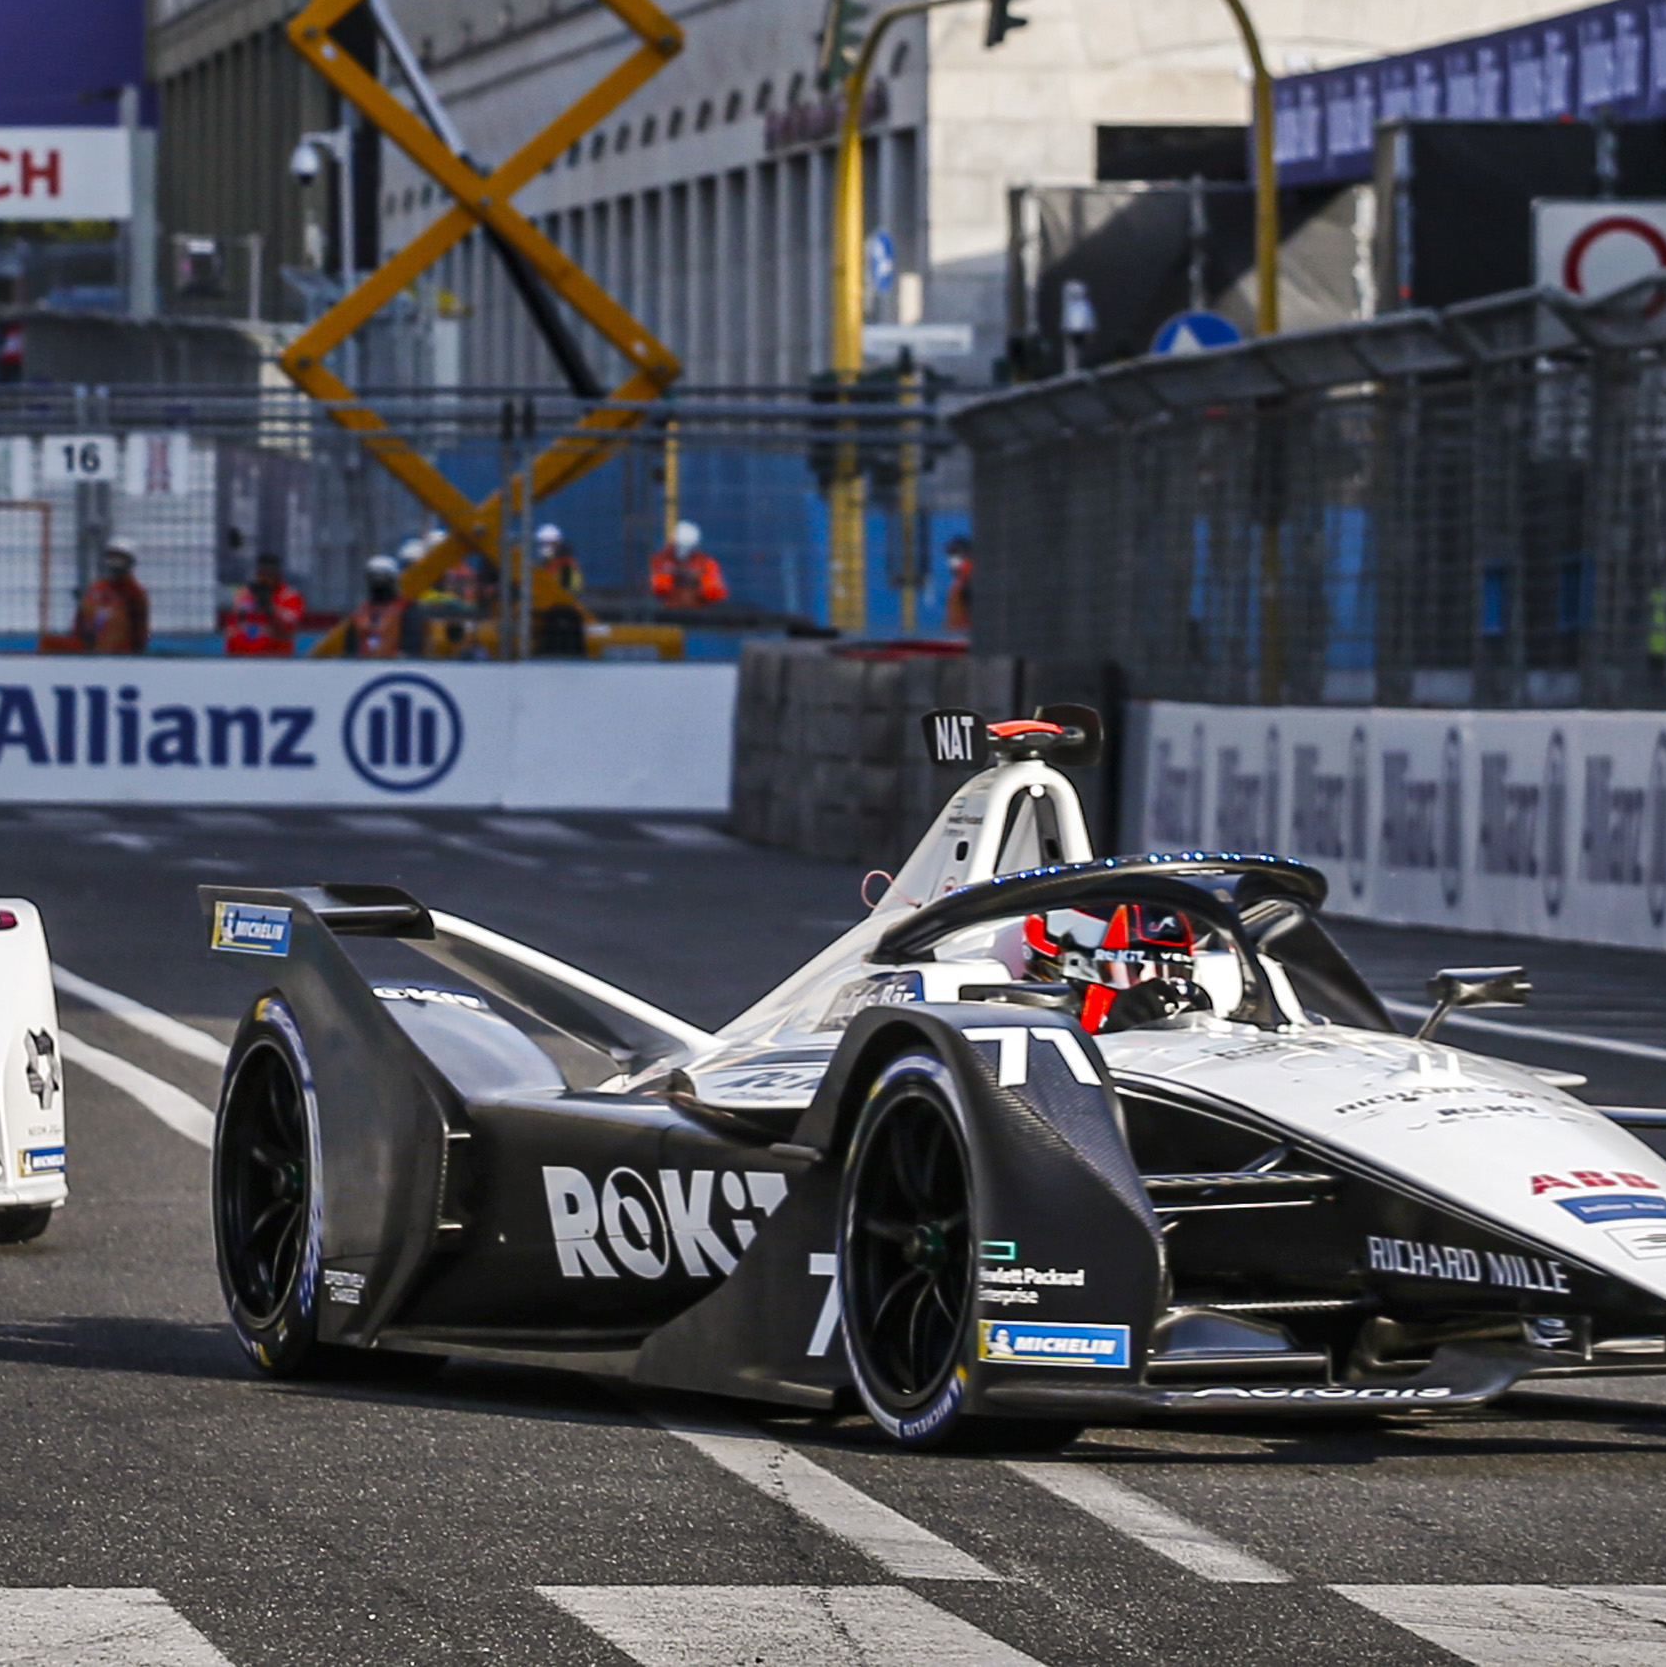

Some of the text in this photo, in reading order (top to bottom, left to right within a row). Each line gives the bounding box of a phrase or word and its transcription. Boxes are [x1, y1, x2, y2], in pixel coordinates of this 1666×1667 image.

[63, 442, 101, 473] 16
[935, 715, 975, 761] NAT
[234, 920, 285, 941] MICHELIN
[961, 1026, 1103, 1088] 71
[1530, 1170, 1661, 1196] ABB
[1023, 1266, 1085, 1287] Packard
[1366, 1235, 1572, 1295] RICHARD MILLE
[1013, 1336, 1117, 1355] MICHELIN
